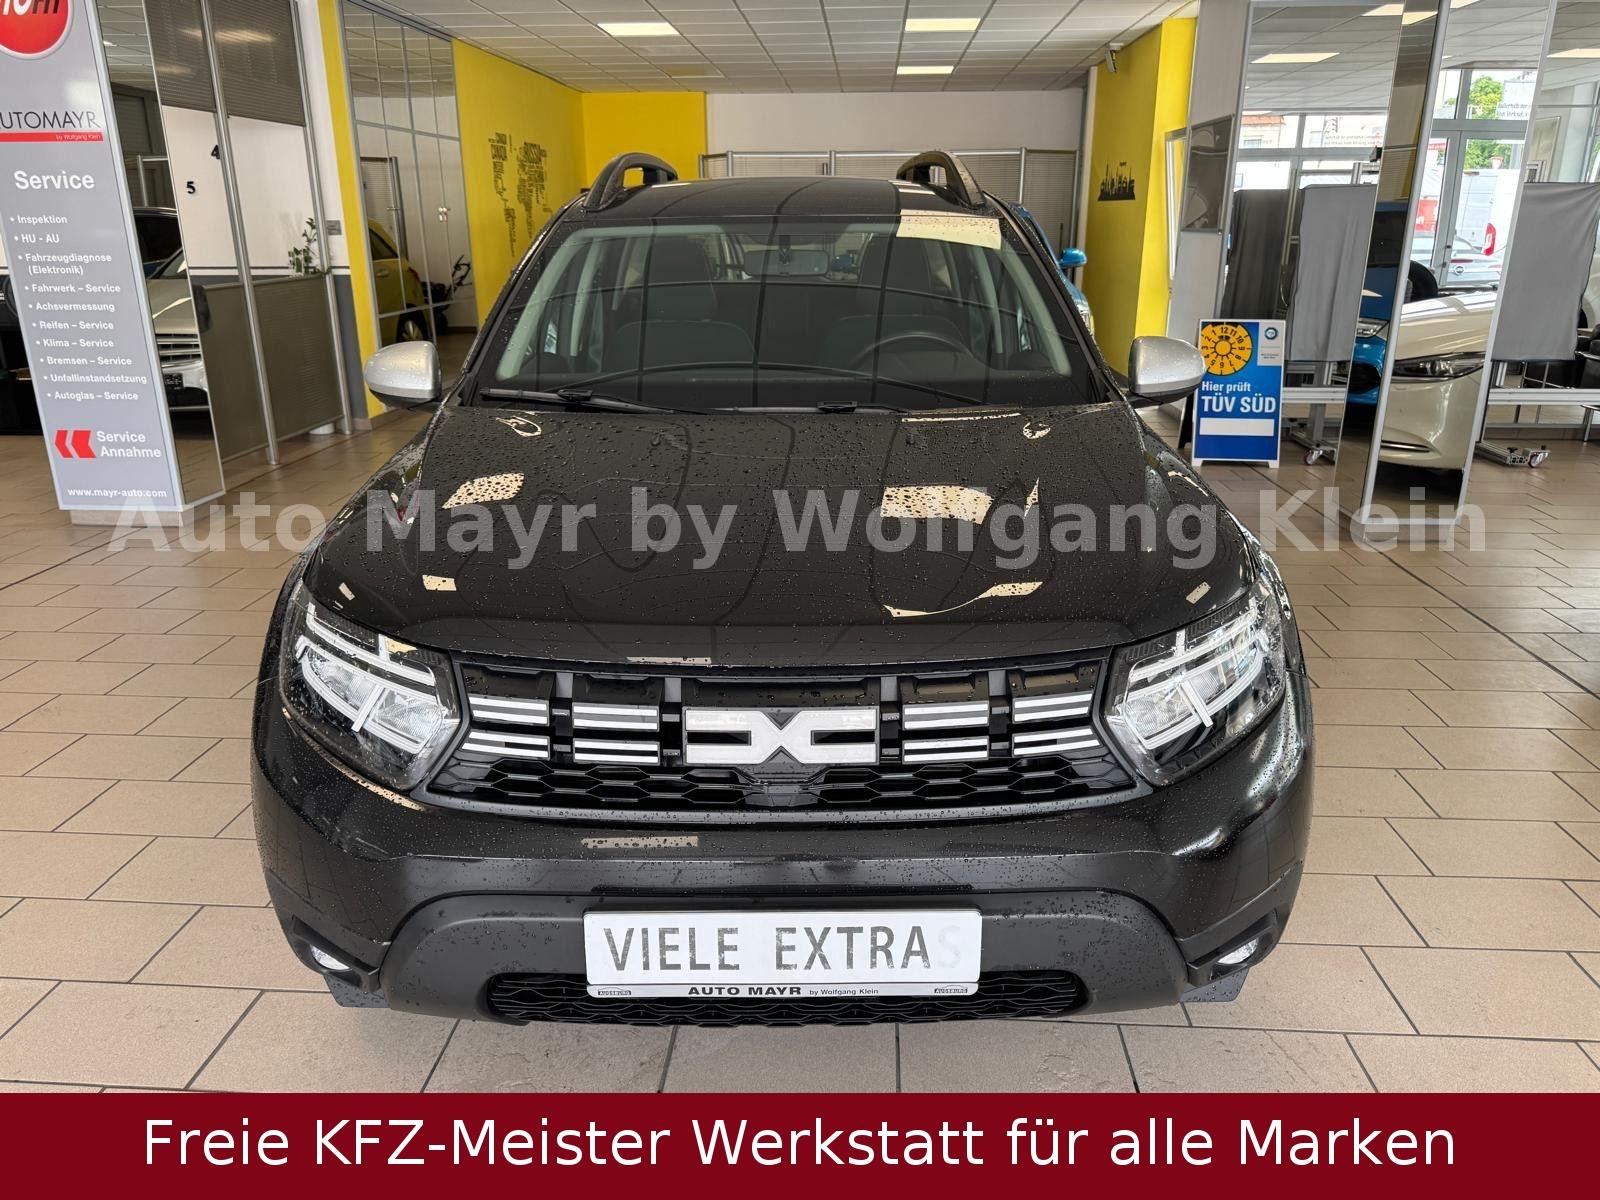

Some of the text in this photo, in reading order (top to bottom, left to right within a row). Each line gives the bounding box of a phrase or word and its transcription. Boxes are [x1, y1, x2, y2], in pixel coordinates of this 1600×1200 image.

[0, 111, 101, 129] UTOMAYR
[211, 145, 220, 160] 4
[14, 170, 95, 189] Service
[186, 181, 196, 194] 5
[17, 215, 68, 225] Inspektion
[21, 234, 36, 243] HU
[46, 234, 60, 243] AU
[25, 253, 112, 263] Fahrzeugdiagnose
[28, 266, 84, 276] (Elektronik)
[32, 284, 76, 292] Fahrwerk
[86, 284, 121, 292] Service
[36, 302, 115, 312] Achsvermessung
[40, 321, 70, 329] Reifen
[79, 321, 114, 330] Service
[43, 338, 70, 347] Klima
[80, 338, 114, 347] Service
[47, 356, 88, 365] Bremsen
[97, 356, 132, 365] Service
[50, 374, 147, 384] Unfallinstandsetzung
[1201, 381, 1251, 394] Hier prüft
[54, 392, 95, 401] Autoglas
[104, 392, 139, 400] Service
[1201, 393, 1276, 413] TÜV SÜD
[96, 431, 146, 442] Service
[100, 446, 162, 458] Annahme
[67, 489, 168, 498] www.mayr-auto.com
[603, 927, 740, 972] VIELE
[688, 986, 740, 996] AUTO
[748, 986, 802, 996] MAYR
[821, 988, 857, 996] Wolfgang
